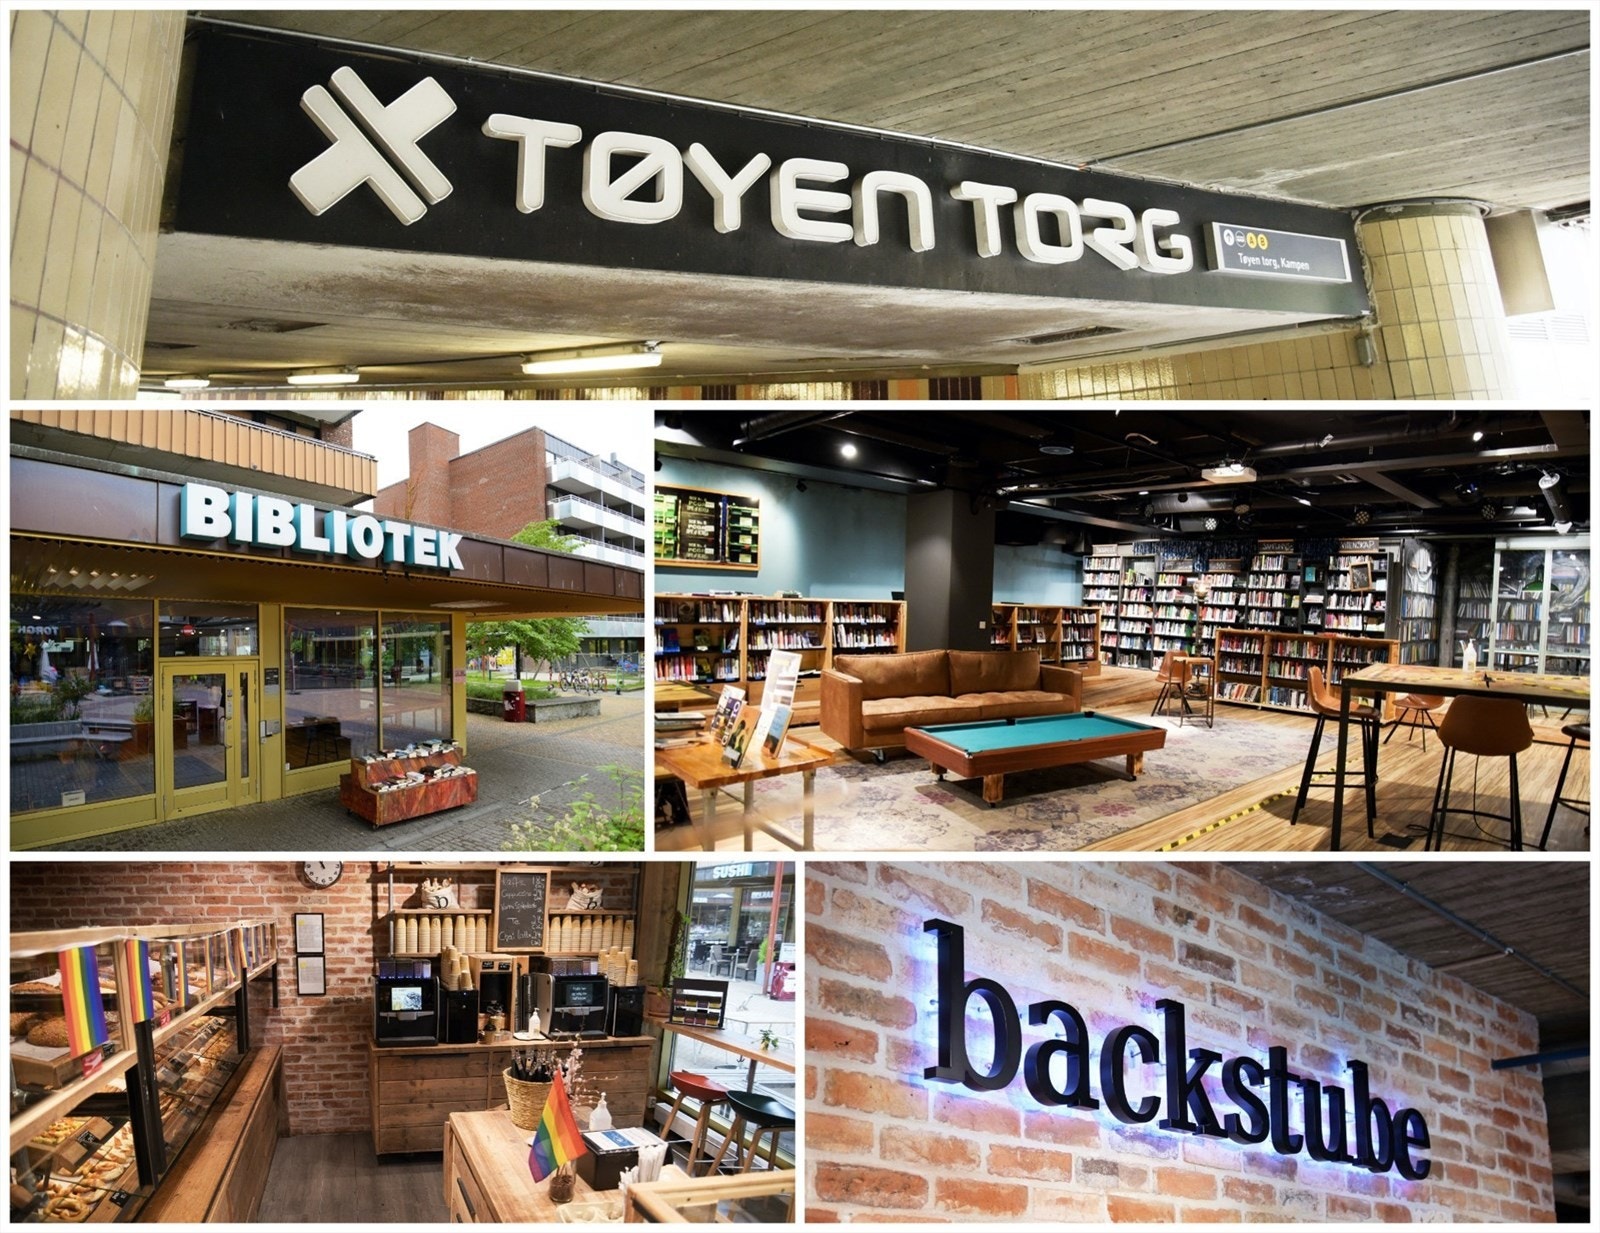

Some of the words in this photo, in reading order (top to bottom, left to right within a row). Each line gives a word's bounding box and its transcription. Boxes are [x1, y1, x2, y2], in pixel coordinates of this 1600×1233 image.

[481, 113, 935, 252] TØYEN
[950, 180, 1193, 274] TORG
[1238, 252, 1260, 267] Tøyen
[1262, 256, 1280, 270] torg,
[1280, 257, 1310, 272] Kampen
[180, 482, 464, 571] BIBLIOTEK
[712, 863, 752, 879] SUSHI
[923, 918, 1433, 1180] backstube
